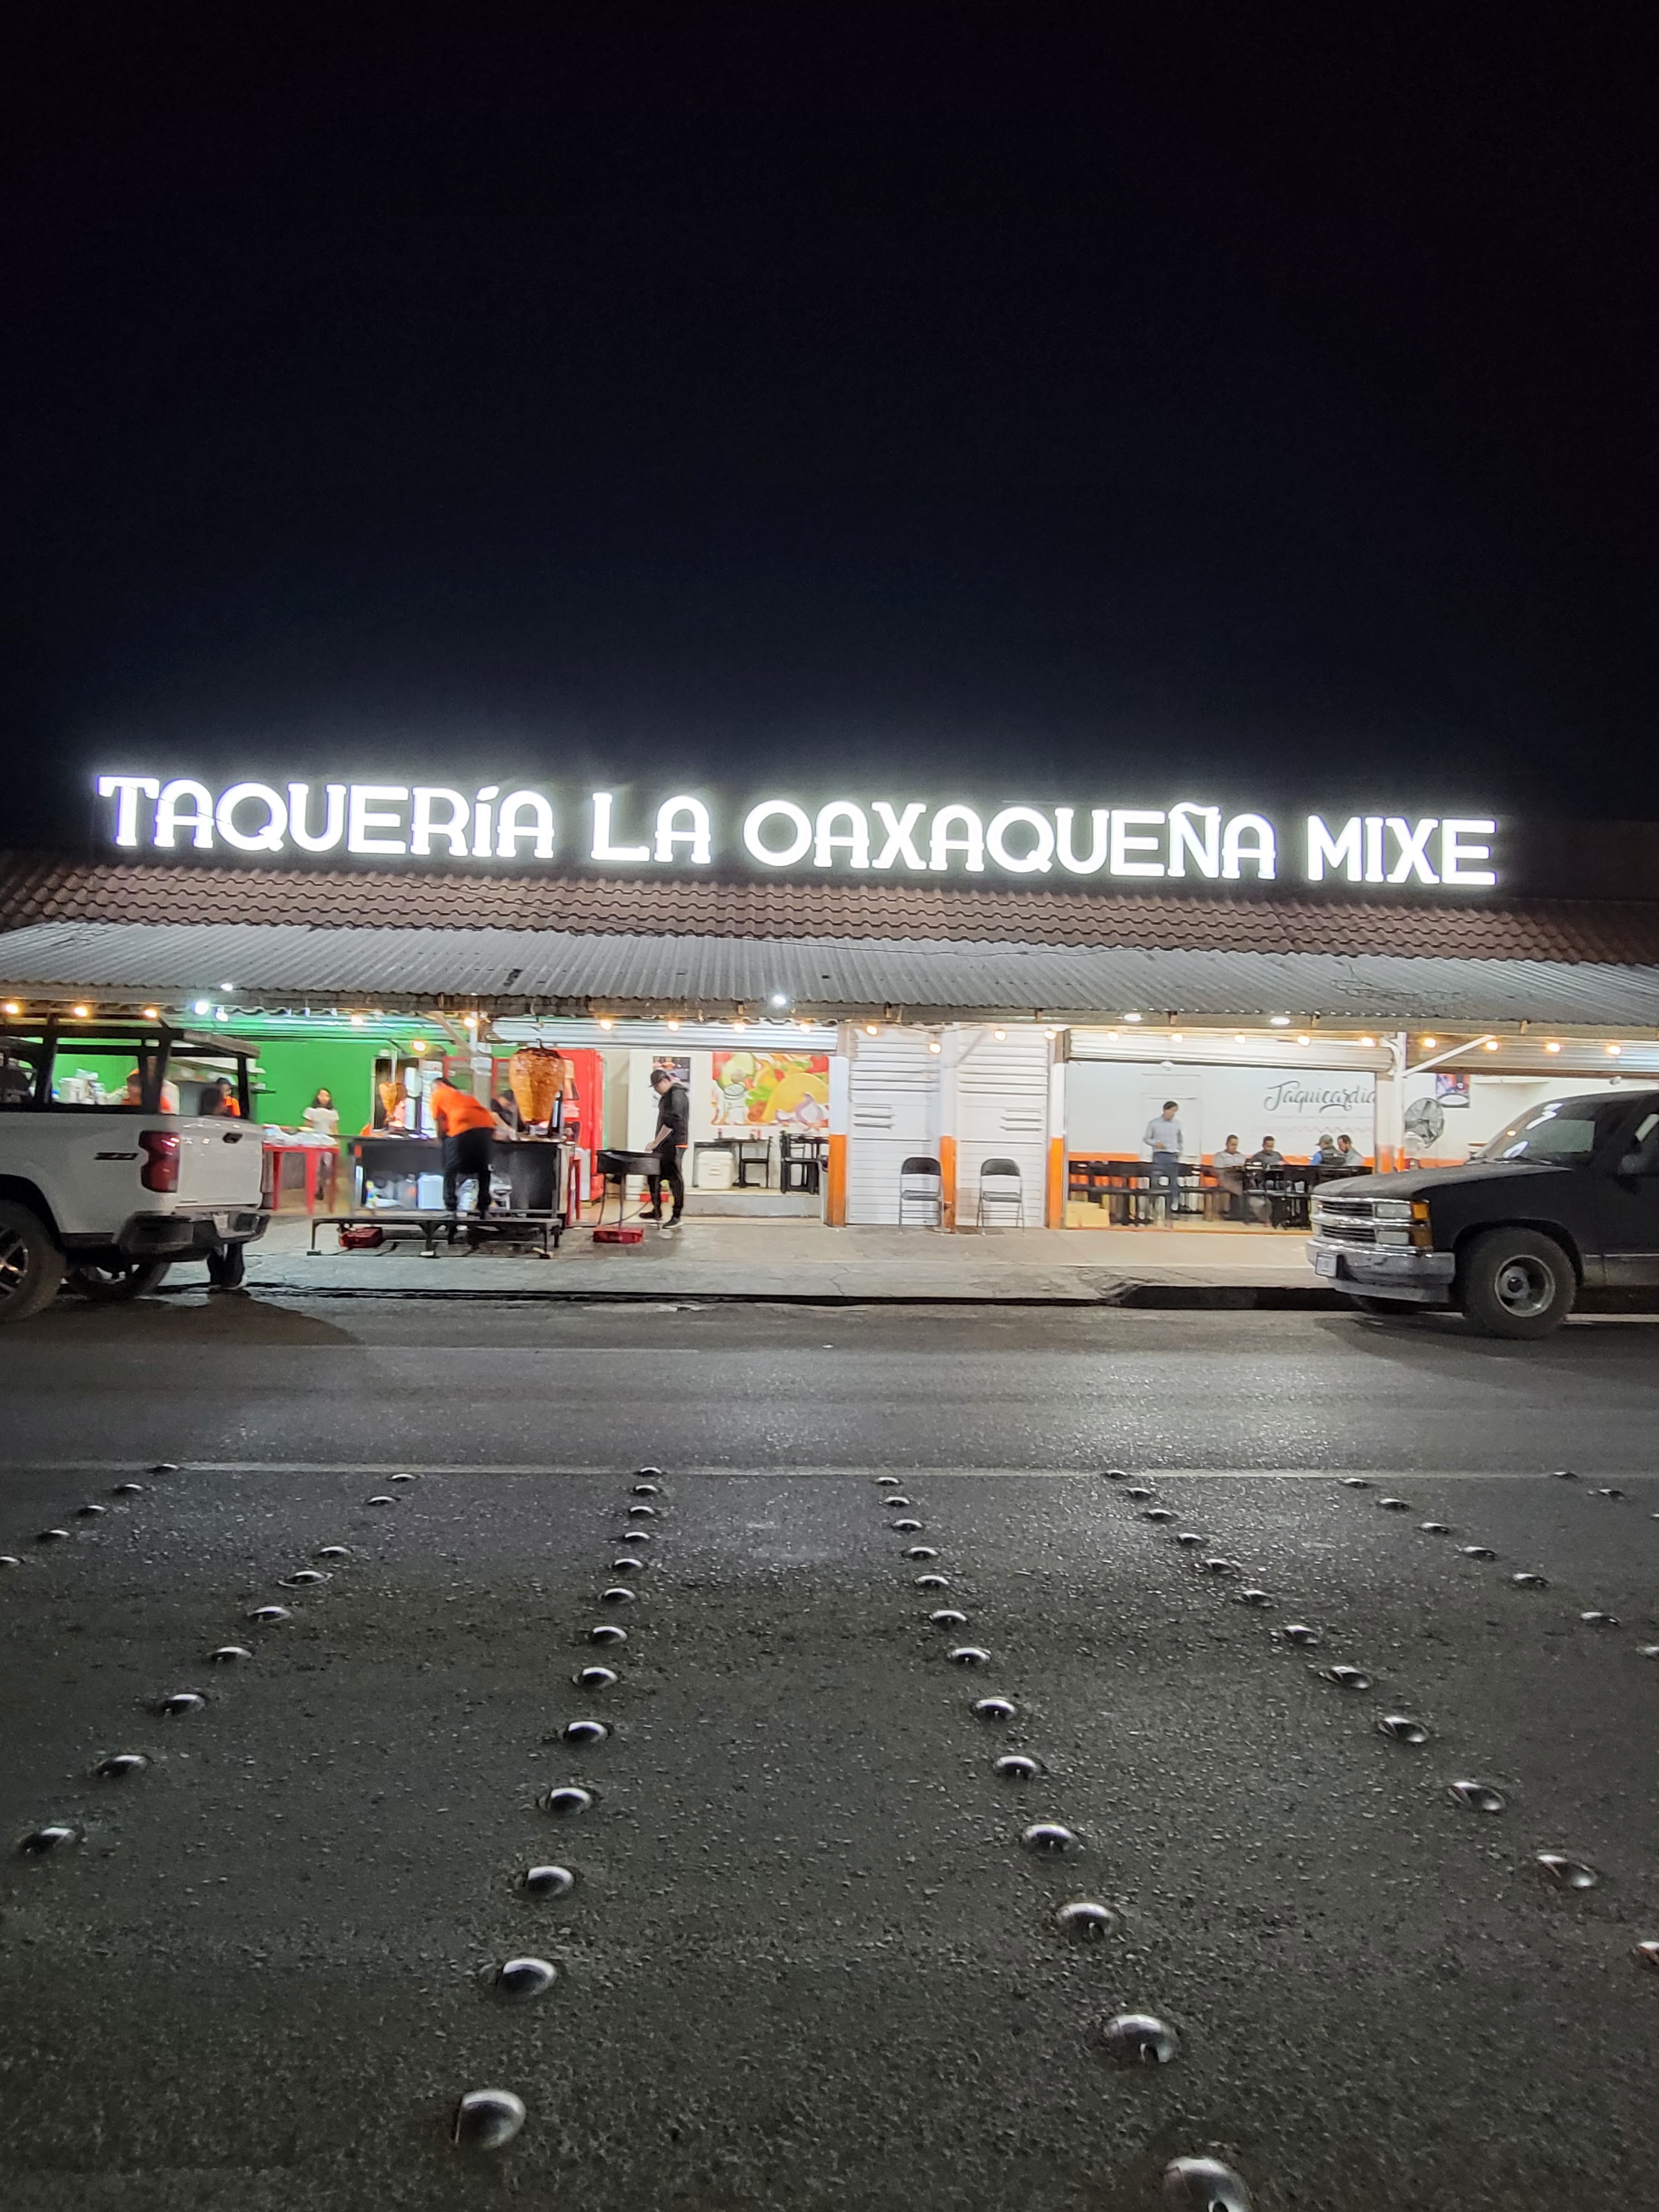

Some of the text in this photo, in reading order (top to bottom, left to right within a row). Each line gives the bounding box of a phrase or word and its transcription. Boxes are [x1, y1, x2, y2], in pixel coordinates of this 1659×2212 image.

[591, 793, 711, 864] LA
[744, 801, 1276, 879] OAXAQUEÑA
[1308, 816, 1495, 885] MIXE
